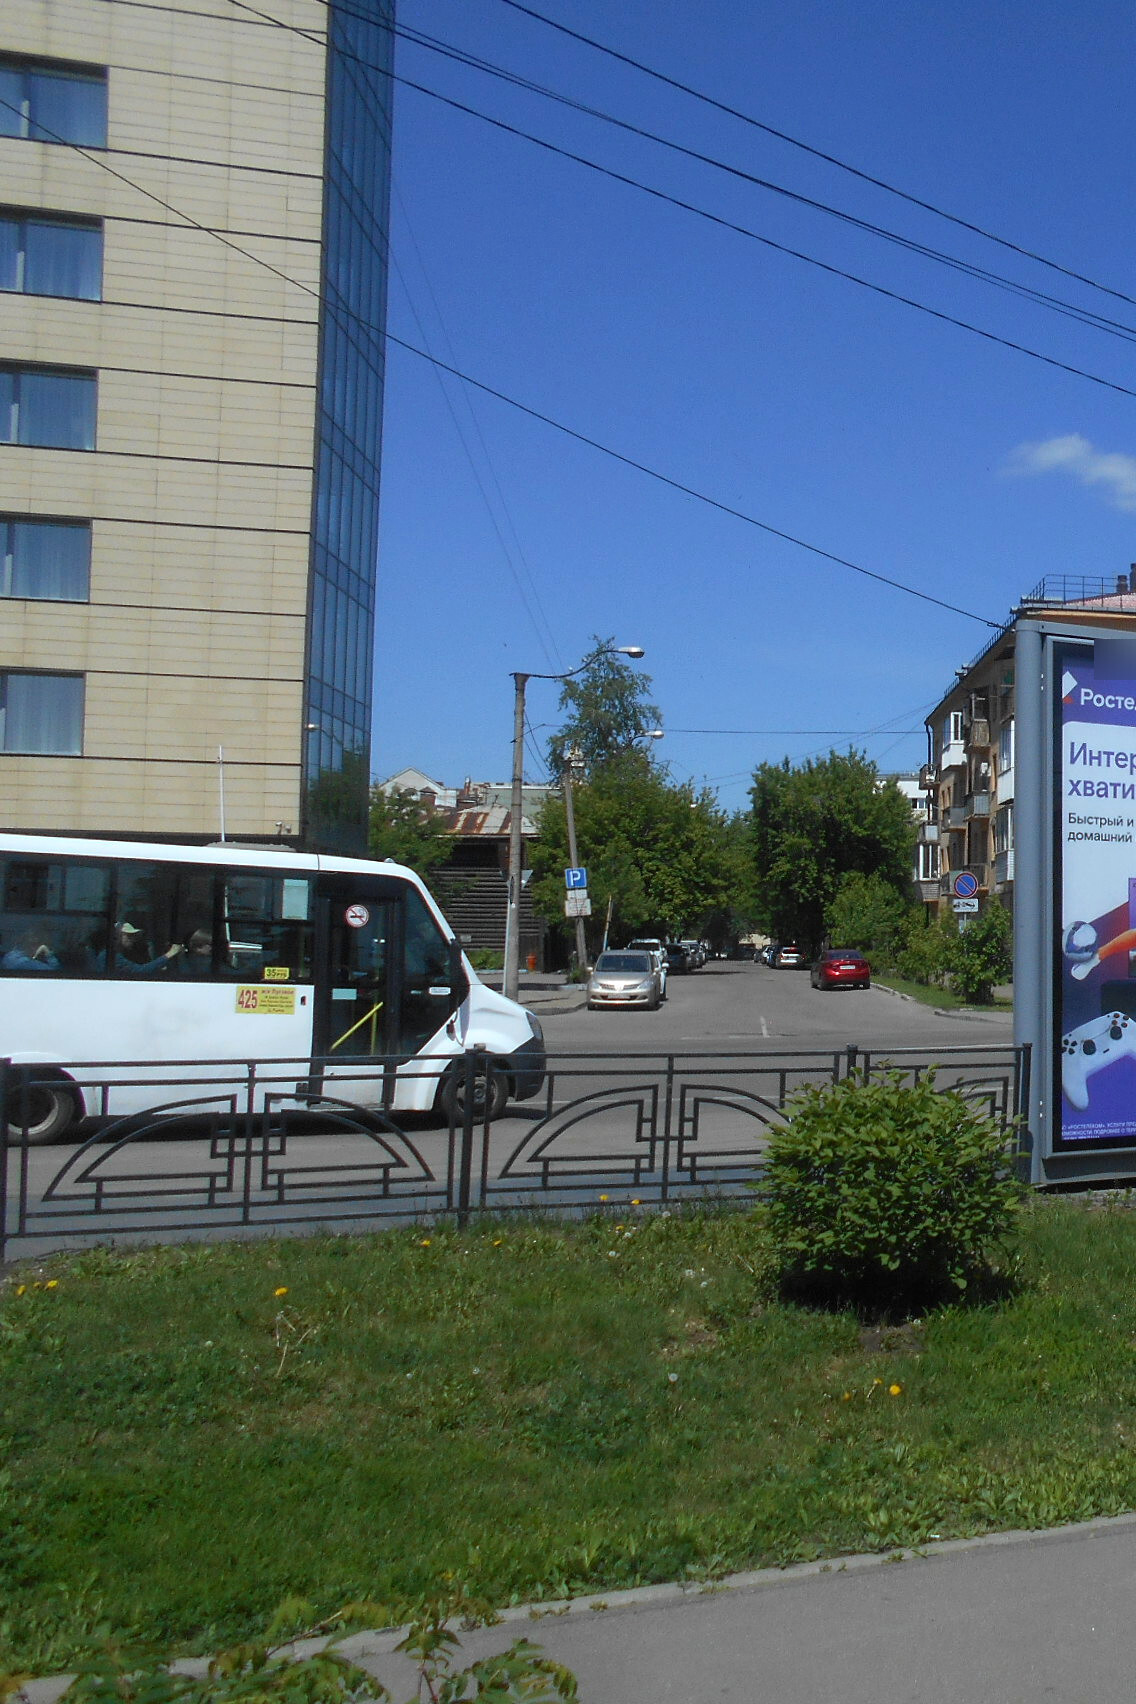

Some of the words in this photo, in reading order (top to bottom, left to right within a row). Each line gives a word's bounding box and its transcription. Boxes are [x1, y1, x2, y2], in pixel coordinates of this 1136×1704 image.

[1068, 812, 1124, 828] Быстрый
[1127, 818, 1134, 827] и
[1068, 830, 1133, 843] домашний
[238, 989, 257, 1009] 425
